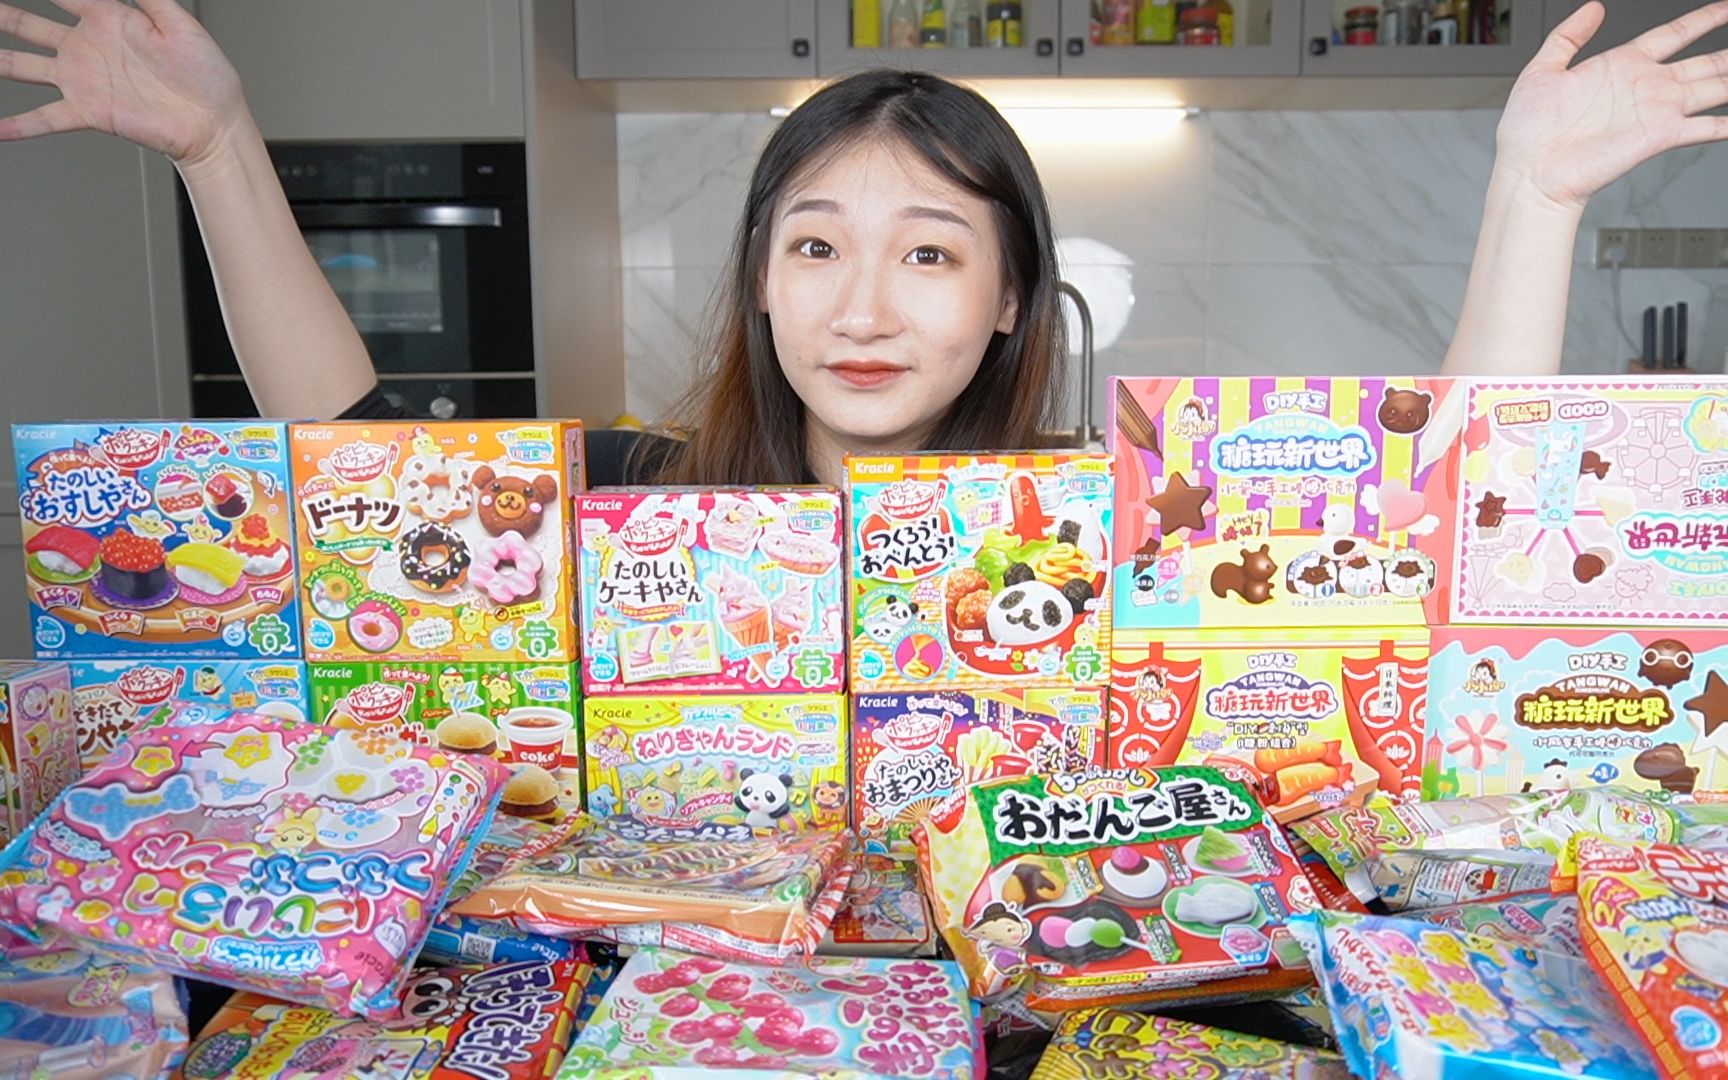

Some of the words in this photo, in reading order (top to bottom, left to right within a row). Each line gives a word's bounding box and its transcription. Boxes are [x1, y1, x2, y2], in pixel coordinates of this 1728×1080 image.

[294, 430, 333, 440] Kracie
[1221, 438, 1368, 469] 糖玩新世界
[49, 469, 116, 489] たのしい
[855, 463, 895, 474] Kracie
[35, 481, 148, 520] おすしやさん
[582, 499, 622, 511] Kracie
[308, 498, 401, 530] ドーナツ
[614, 560, 686, 579] たのしい
[599, 578, 703, 603] ケーキやさん
[314, 668, 353, 678] Kracie
[1568, 653, 1628, 671] DIY手工
[1240, 673, 1301, 687] TANGWAN
[1556, 678, 1631, 694] TANGWAN
[859, 696, 898, 708] Kracie
[1214, 689, 1333, 714] 糖玩新世界
[1523, 696, 1668, 727] 糖玩新世界
[593, 708, 632, 719] Kracie
[519, 750, 555, 762] coke
[879, 753, 931, 780] たのしい
[865, 757, 962, 803] おまつりやさん
[1000, 783, 1248, 841] おだんご屋さん
[135, 834, 433, 897] つぶつぶランド
[176, 883, 373, 935] にじいろ
[210, 948, 321, 971] カラフルピース
[354, 950, 387, 982] racie
